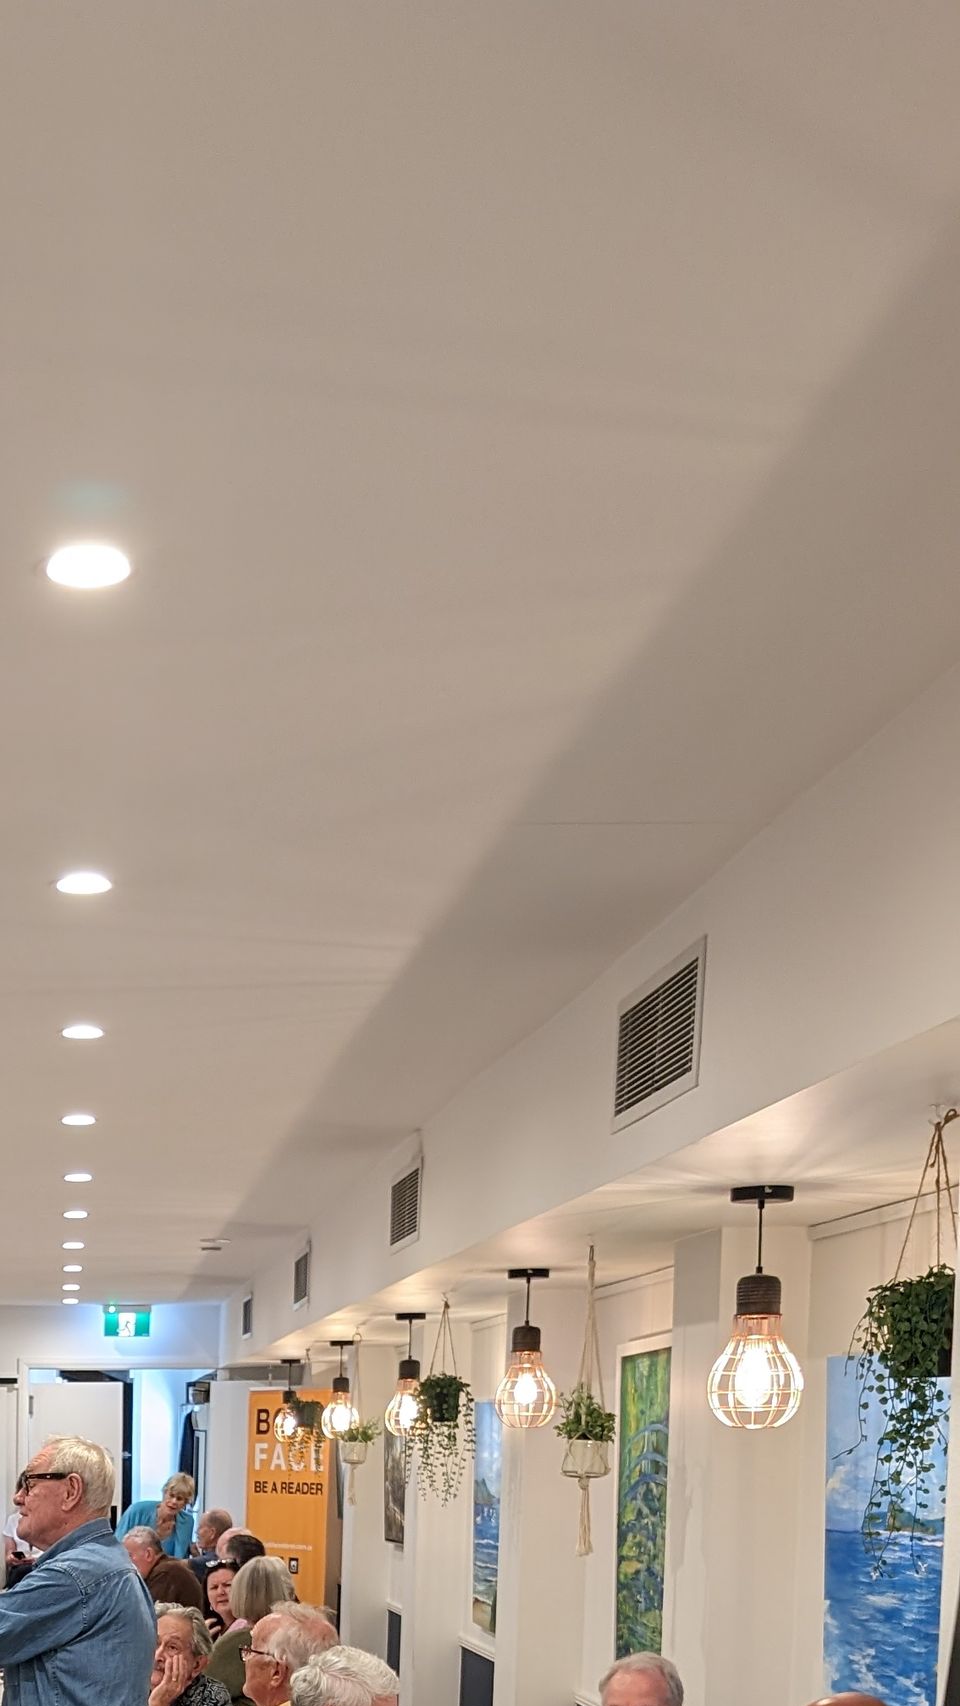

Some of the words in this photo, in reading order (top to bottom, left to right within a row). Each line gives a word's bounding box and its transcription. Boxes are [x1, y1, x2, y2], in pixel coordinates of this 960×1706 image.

[254, 1443, 324, 1472] FACE
[254, 1481, 268, 1494] BE
[271, 1481, 278, 1494] A
[280, 1482, 323, 1496] READER
